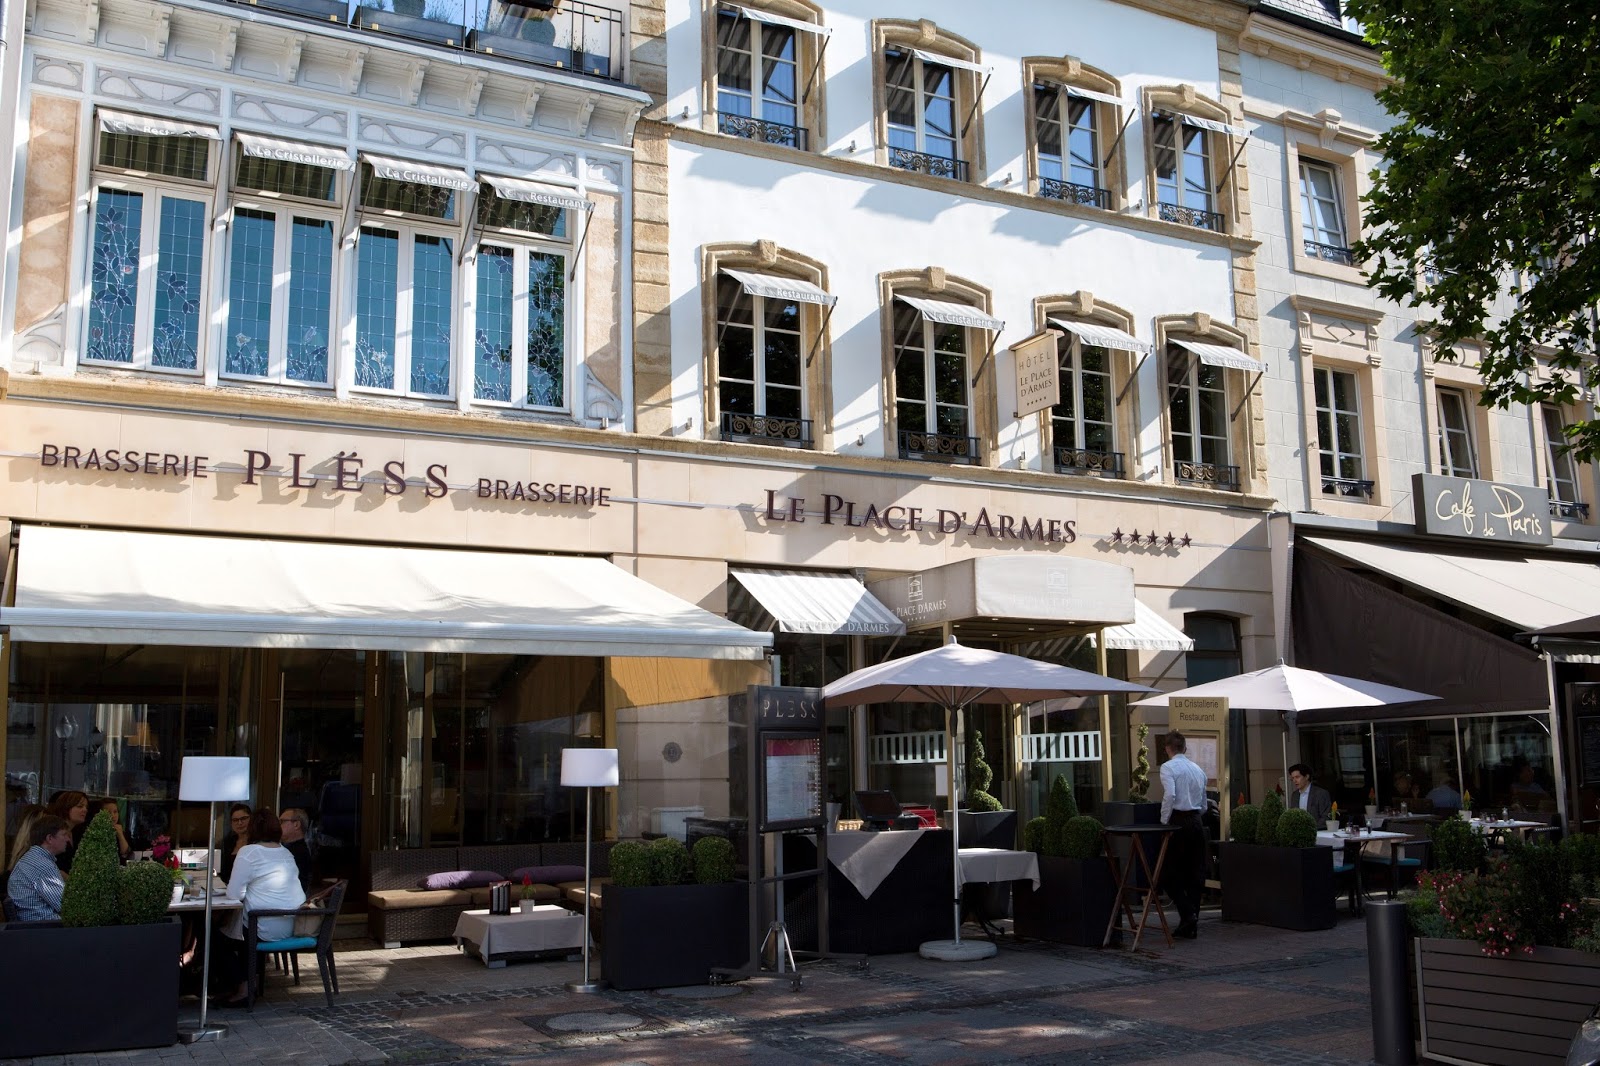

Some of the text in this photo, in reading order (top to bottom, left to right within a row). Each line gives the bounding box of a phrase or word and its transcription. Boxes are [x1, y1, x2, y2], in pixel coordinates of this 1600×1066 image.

[256, 145, 344, 167] La Cristallerie
[386, 167, 468, 189] La Cristallerie
[530, 191, 585, 209] Restaurant
[777, 288, 825, 301] Restaurant
[946, 314, 993, 327] Cristallerie
[1100, 336, 1142, 350] Cristallerie
[1018, 351, 1051, 371] HÔTEL
[1030, 367, 1052, 383] PLACE
[1020, 379, 1053, 397] D'ARMES
[41, 444, 612, 508] BRASSERIE PLËSS BRASSERIE
[763, 488, 1077, 545] LE PLACE D'ARMES
[1435, 481, 1543, 537] Café de Paris
[896, 605, 916, 618] PLACE
[917, 599, 947, 614] D'ARMES
[847, 621, 890, 633] D'ARMES
[1174, 698, 1219, 709] La Cristallerie
[1179, 712, 1215, 722] Restaurant
